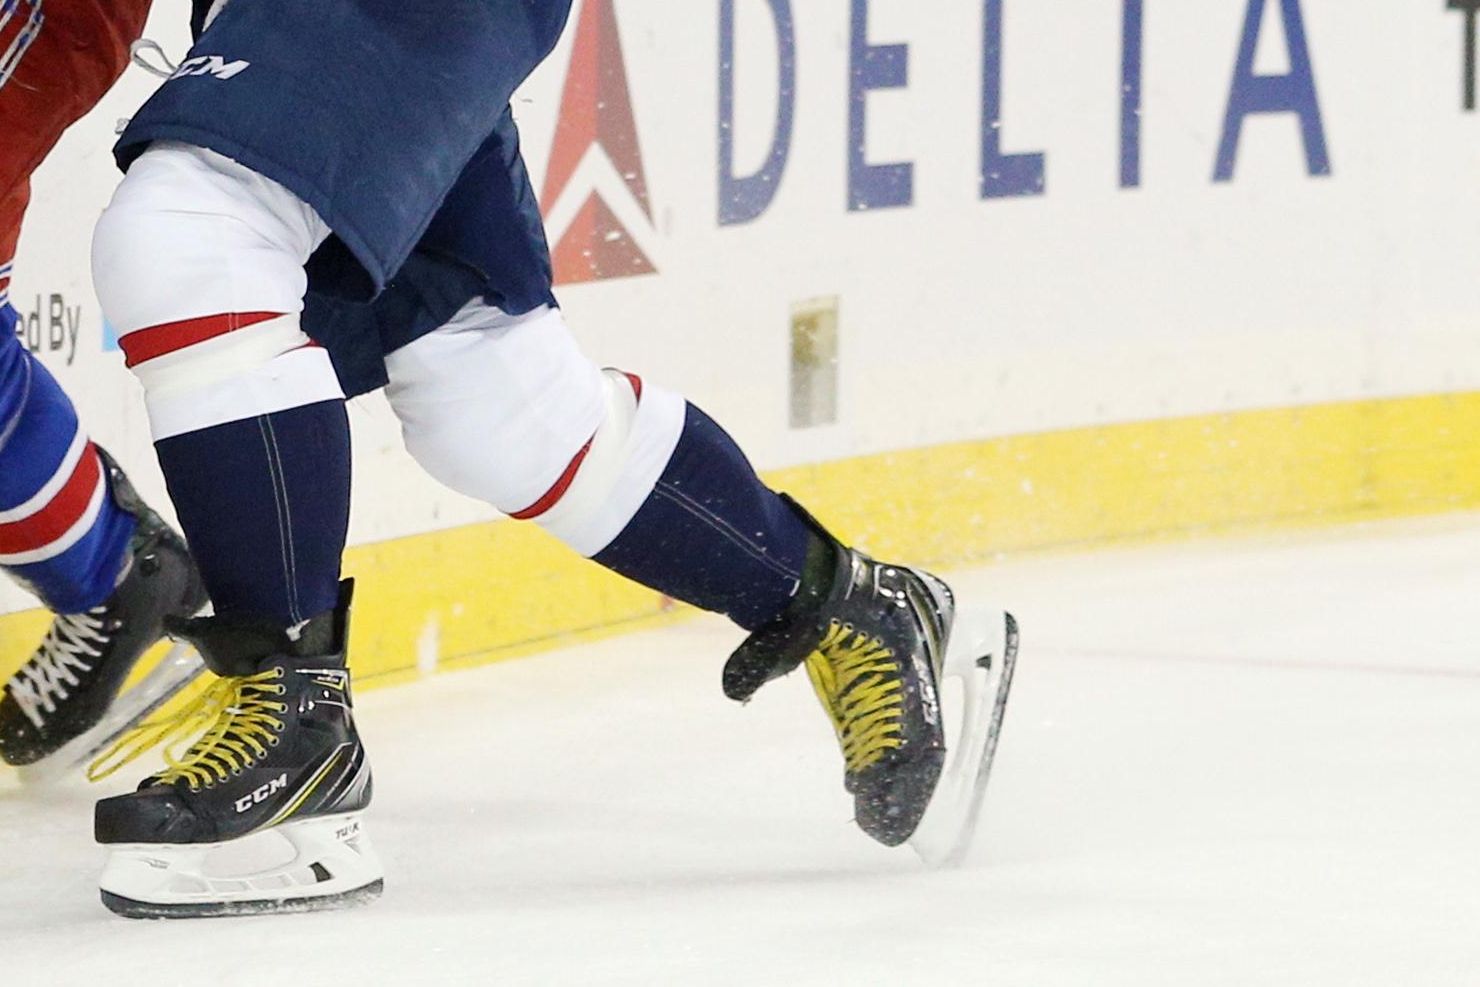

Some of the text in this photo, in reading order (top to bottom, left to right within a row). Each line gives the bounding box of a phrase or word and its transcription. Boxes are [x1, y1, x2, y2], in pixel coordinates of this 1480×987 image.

[14, 293, 81, 366] ed By
[234, 772, 288, 813] CCM
